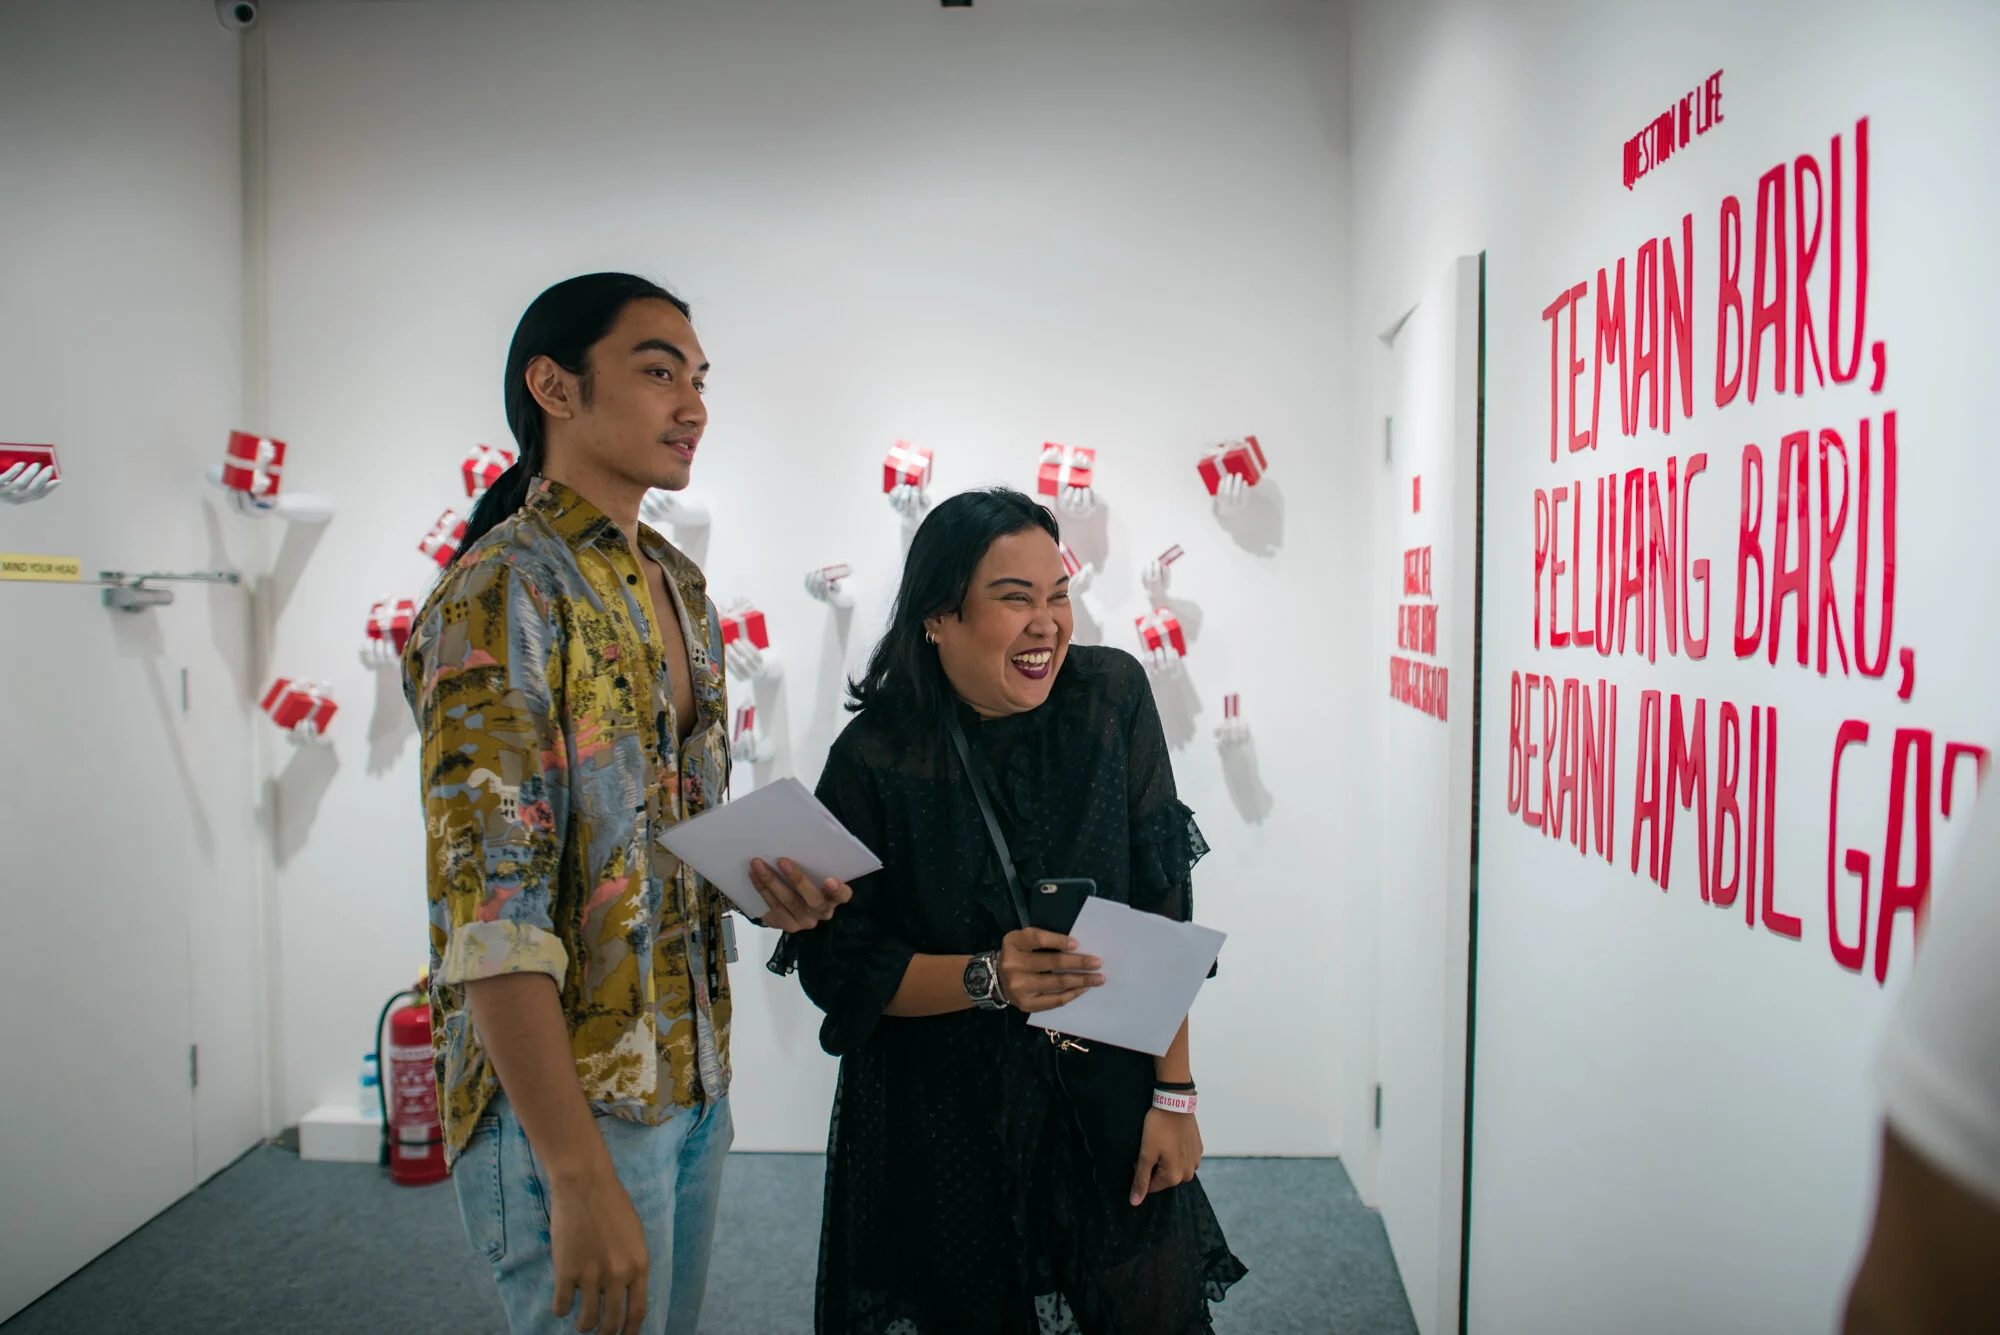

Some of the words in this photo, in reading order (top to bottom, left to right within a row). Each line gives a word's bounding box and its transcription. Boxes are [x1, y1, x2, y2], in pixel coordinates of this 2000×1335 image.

[1622, 103, 1676, 191] QUESTION
[1678, 91, 1694, 149] OF
[1695, 69, 1724, 135] LIFE
[1542, 213, 1693, 463] TEMAN
[1714, 115, 1888, 409] BARU,
[2, 561, 28, 573] MIND
[29, 562, 53, 574] YOUR
[54, 563, 78, 575] HEAD
[1533, 453, 1711, 663] PELUANG
[1732, 410, 1916, 701] BARU,
[1507, 669, 1618, 863] BERANI
[1630, 689, 1803, 939] AMBIL
